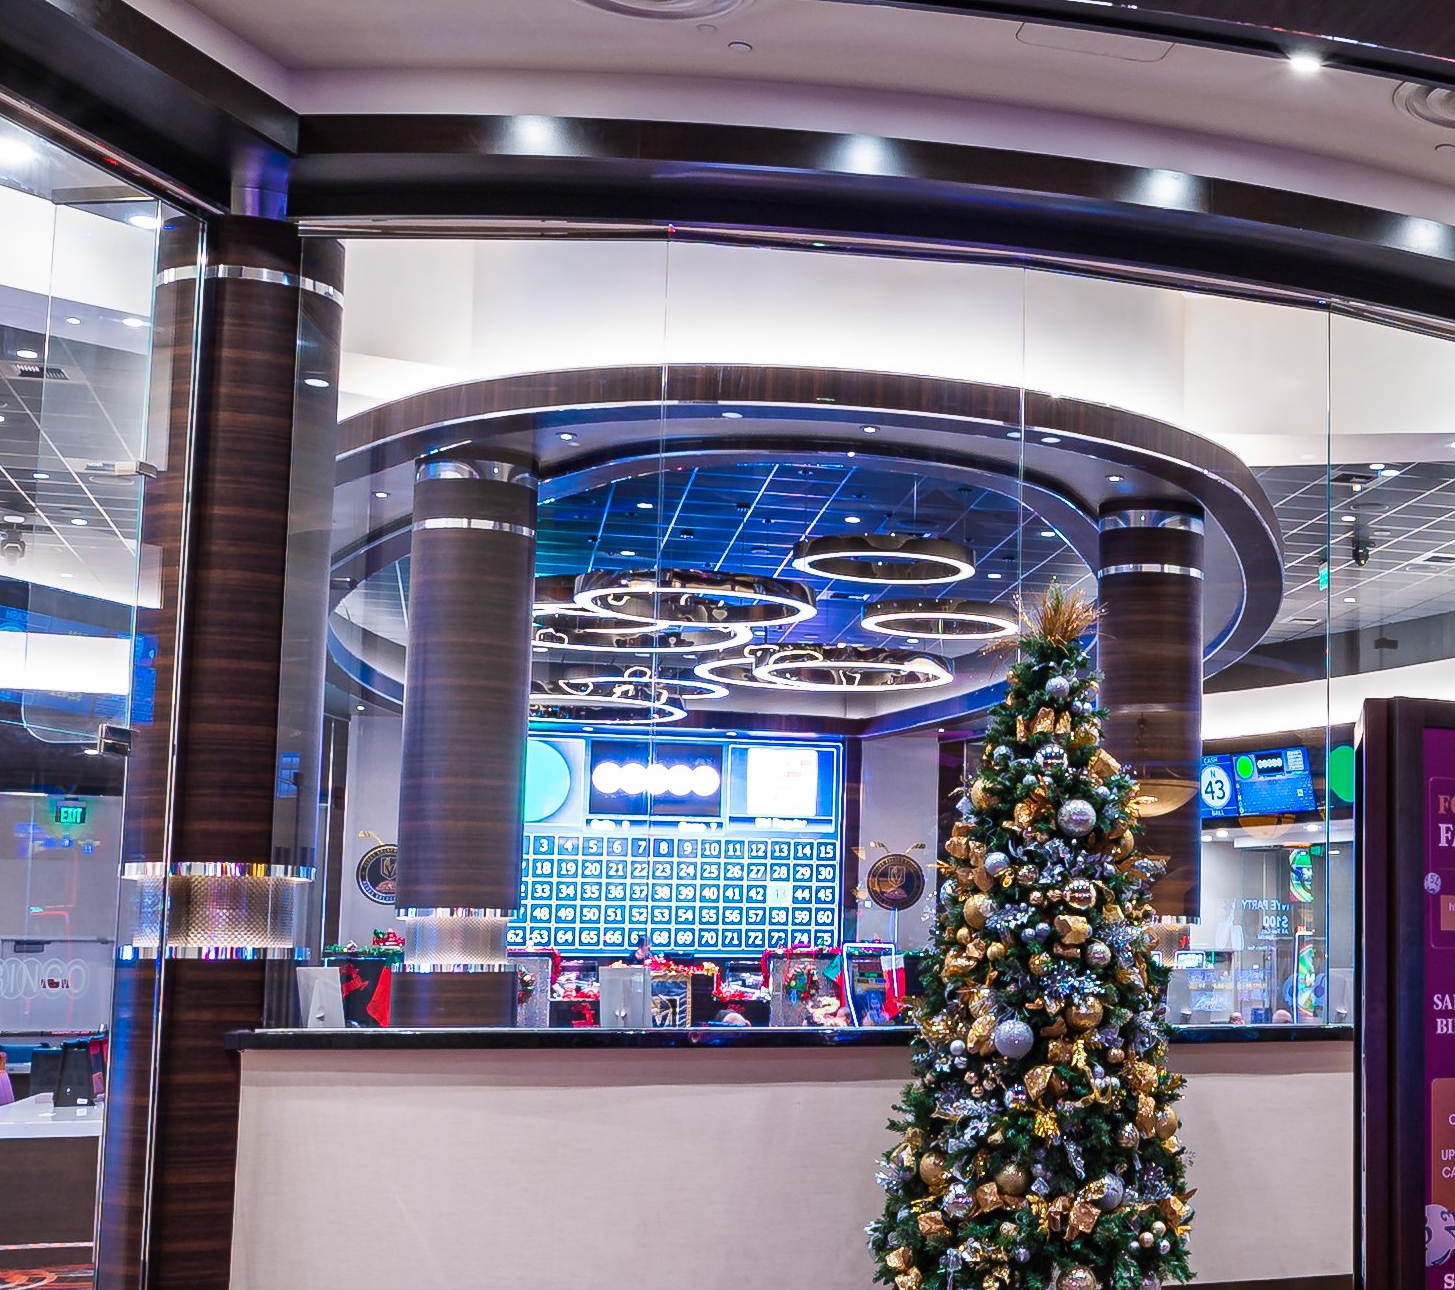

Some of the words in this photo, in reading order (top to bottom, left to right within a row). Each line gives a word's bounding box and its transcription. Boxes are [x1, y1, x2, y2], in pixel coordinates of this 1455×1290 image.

[1205, 780, 1225, 800] 43
[60, 807, 82, 824] EXIT
[539, 838, 549, 852] 3
[564, 839, 573, 852] 4
[588, 840, 597, 853] 5
[612, 840, 622, 853] 6
[638, 841, 646, 854] 7
[659, 841, 668, 854] 8
[683, 842, 693, 855] 9
[704, 843, 719, 856] 10
[727, 843, 742, 856] 11
[750, 843, 765, 856] 12
[773, 844, 788, 856] 13
[796, 844, 811, 857] 14
[819, 845, 833, 858] 15
